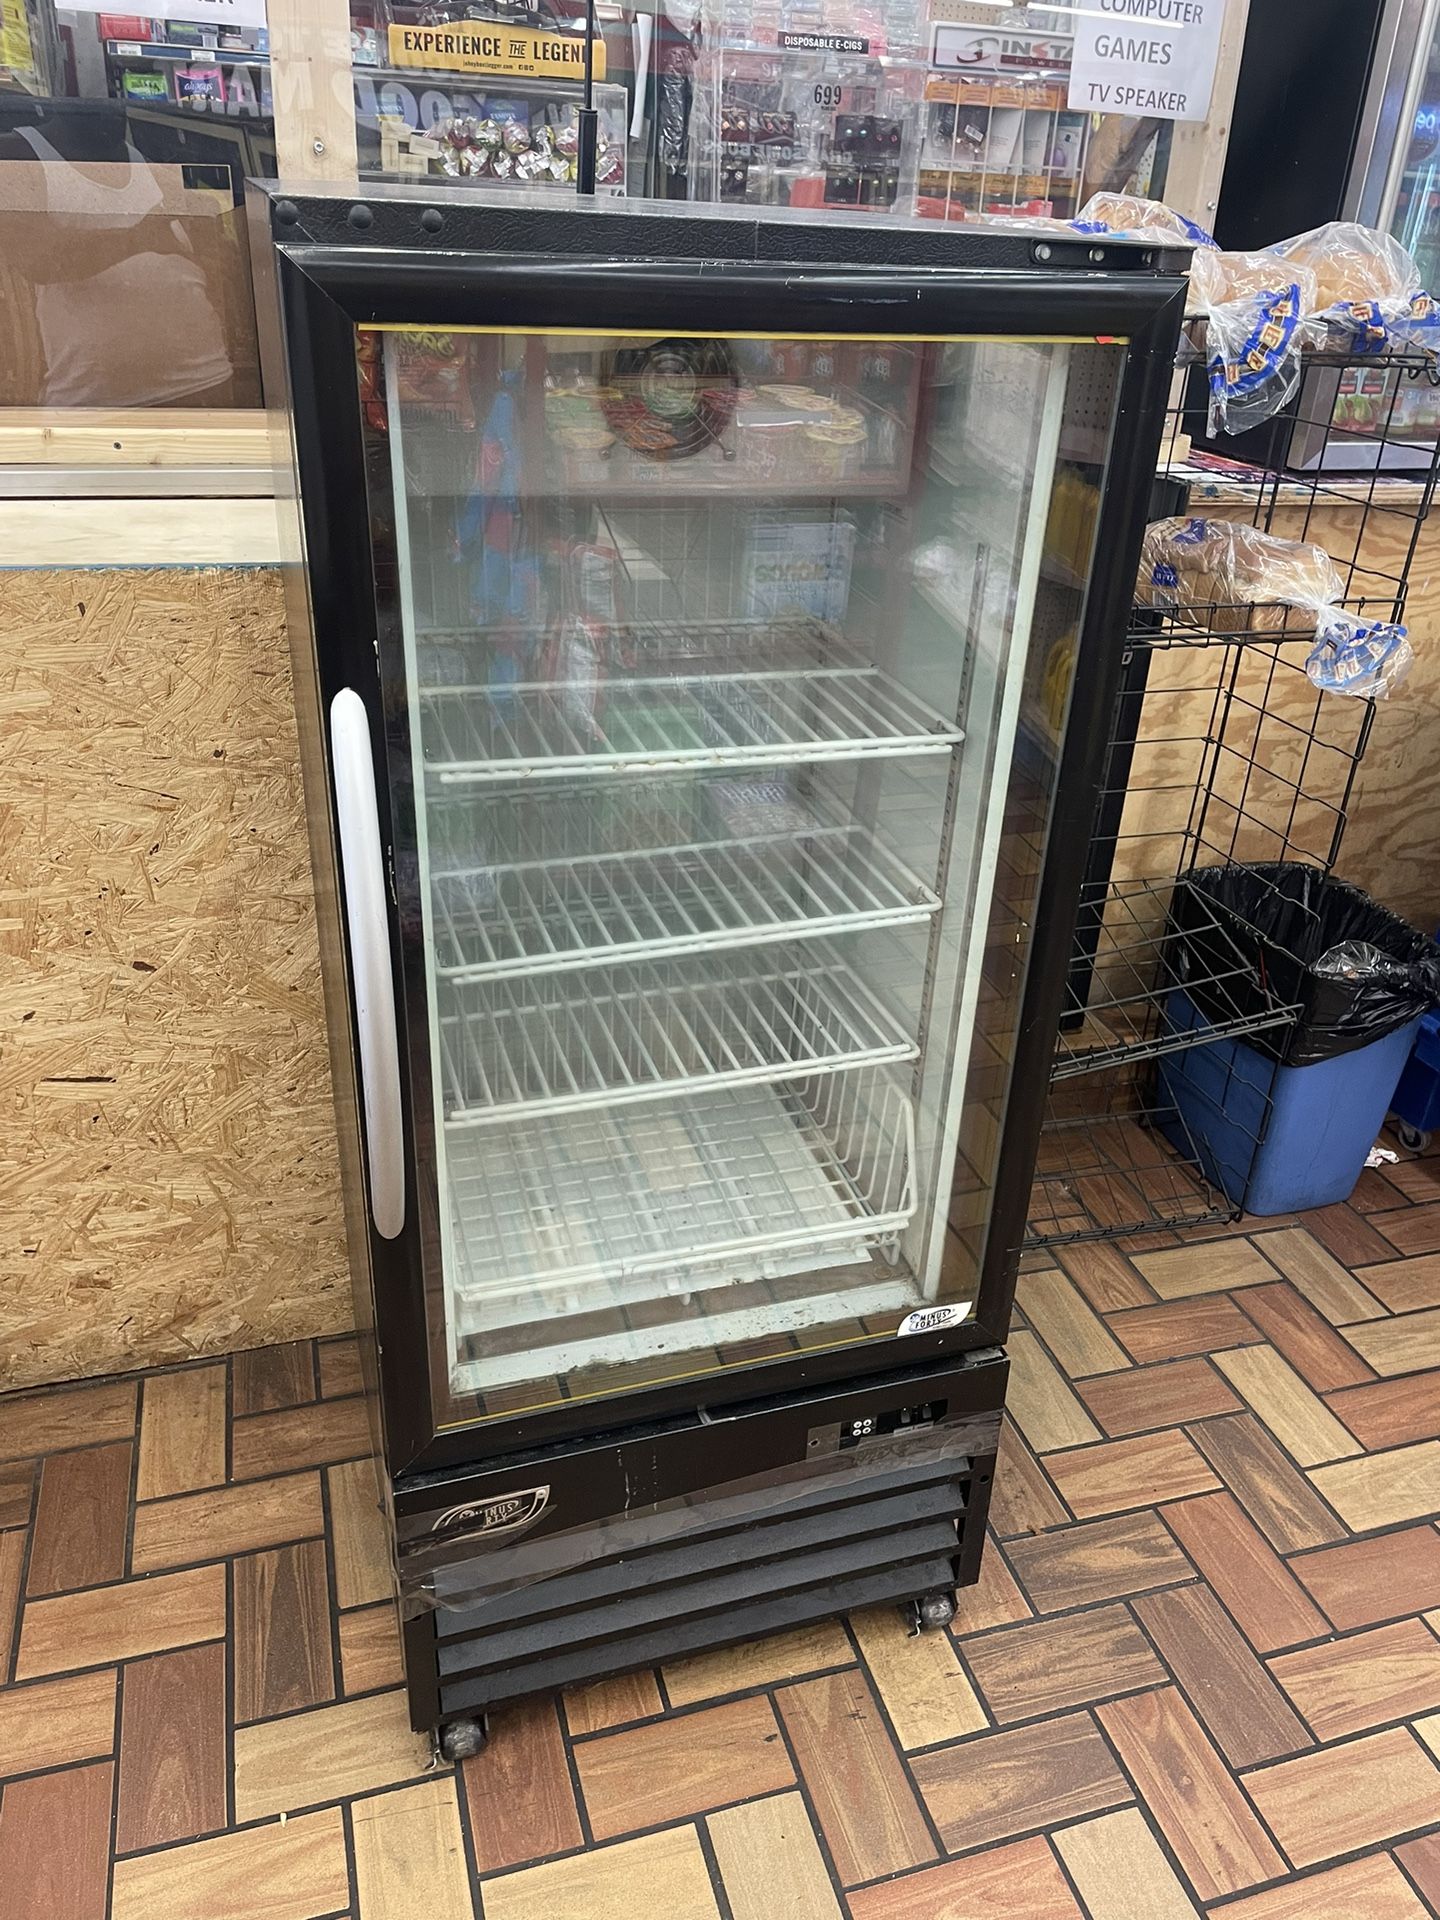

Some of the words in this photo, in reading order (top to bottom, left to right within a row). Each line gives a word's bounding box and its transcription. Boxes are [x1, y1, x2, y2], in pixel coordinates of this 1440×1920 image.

[1100, 0, 1204, 24] COMPUTER
[404, 31, 501, 57] EXPERIENCE
[509, 42, 526, 56] THE
[784, 36, 834, 49] DISPOSABLE
[835, 39, 863, 51] E-CIGS
[1094, 34, 1172, 65] GAMES
[184, 81, 213, 94] always
[814, 84, 842, 105] 699
[1088, 83, 1111, 102] TV
[1114, 86, 1187, 112] SPEAKER
[915, 1319, 942, 1329] FORTY
[920, 1311, 948, 1321] MINUS
[475, 1503, 513, 1518] INUS
